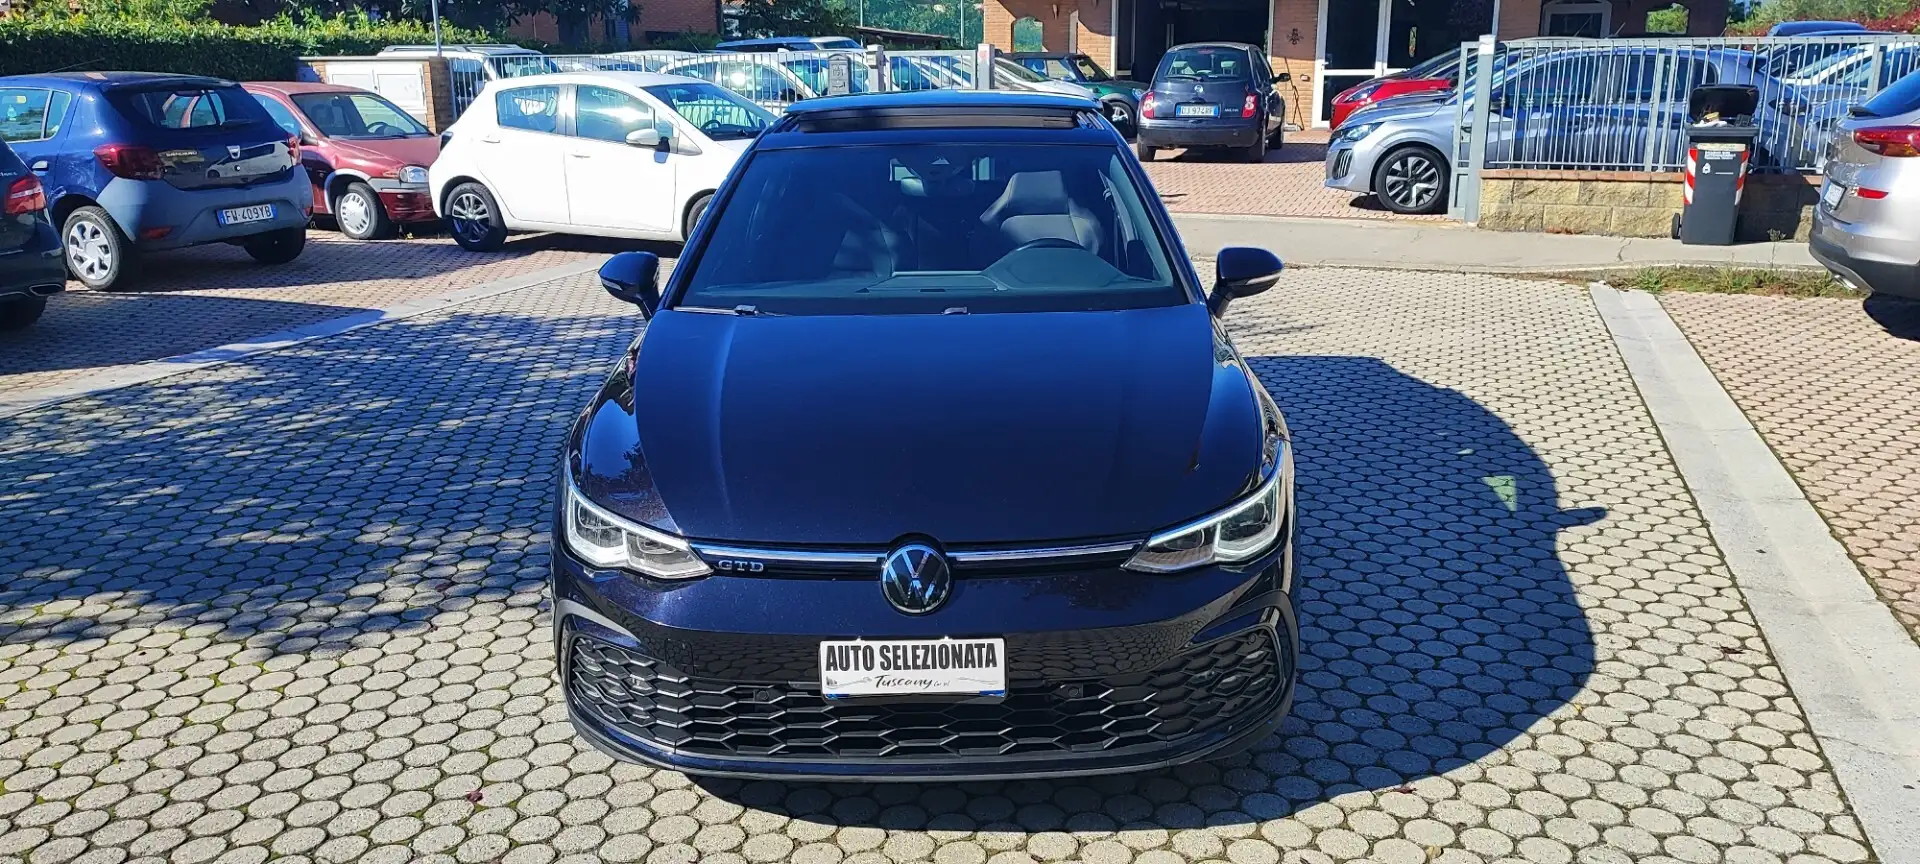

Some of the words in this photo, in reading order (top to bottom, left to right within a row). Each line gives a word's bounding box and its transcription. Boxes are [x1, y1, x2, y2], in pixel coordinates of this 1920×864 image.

[718, 560, 764, 572] GTD
[825, 645, 875, 672] AUTO
[879, 643, 998, 671] SELEZIONATA
[874, 674, 933, 690] Tuscany
